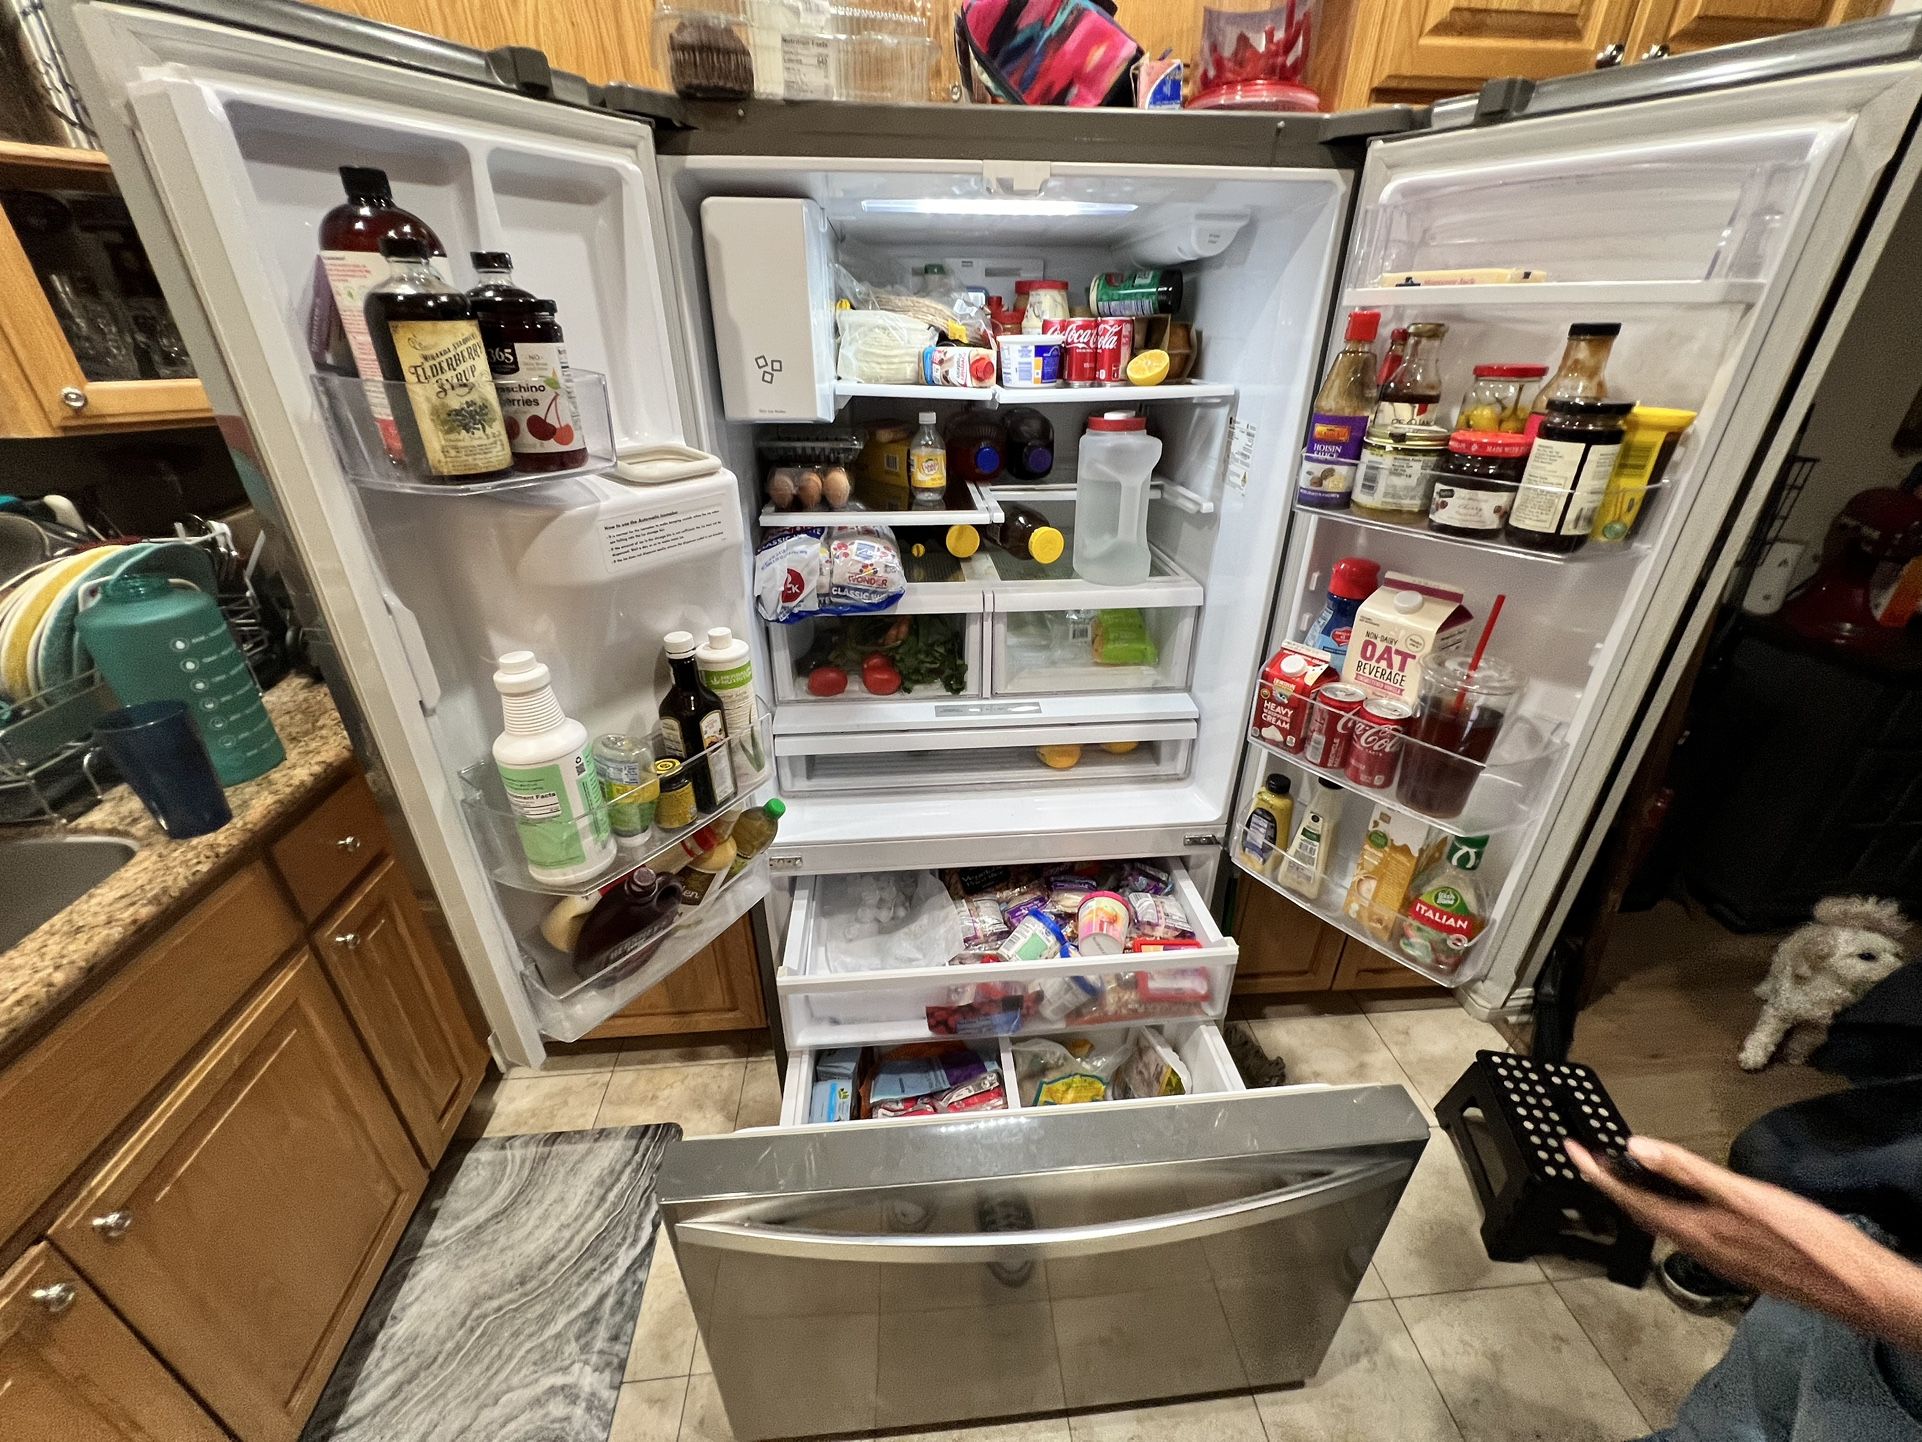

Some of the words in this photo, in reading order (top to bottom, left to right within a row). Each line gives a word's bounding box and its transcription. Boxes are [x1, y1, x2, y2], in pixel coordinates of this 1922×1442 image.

[407, 340, 484, 385] ELDERBERRY
[436, 363, 478, 400] SYRUP
[1313, 442, 1343, 454] HOISIN
[832, 586, 870, 600] CLASSIC
[1360, 639, 1417, 674] OAT
[1355, 660, 1407, 687] BEVERAGE
[1261, 713, 1291, 731] CREAM
[1263, 700, 1293, 718] HEAVY
[1415, 902, 1469, 930] ITALIAN
